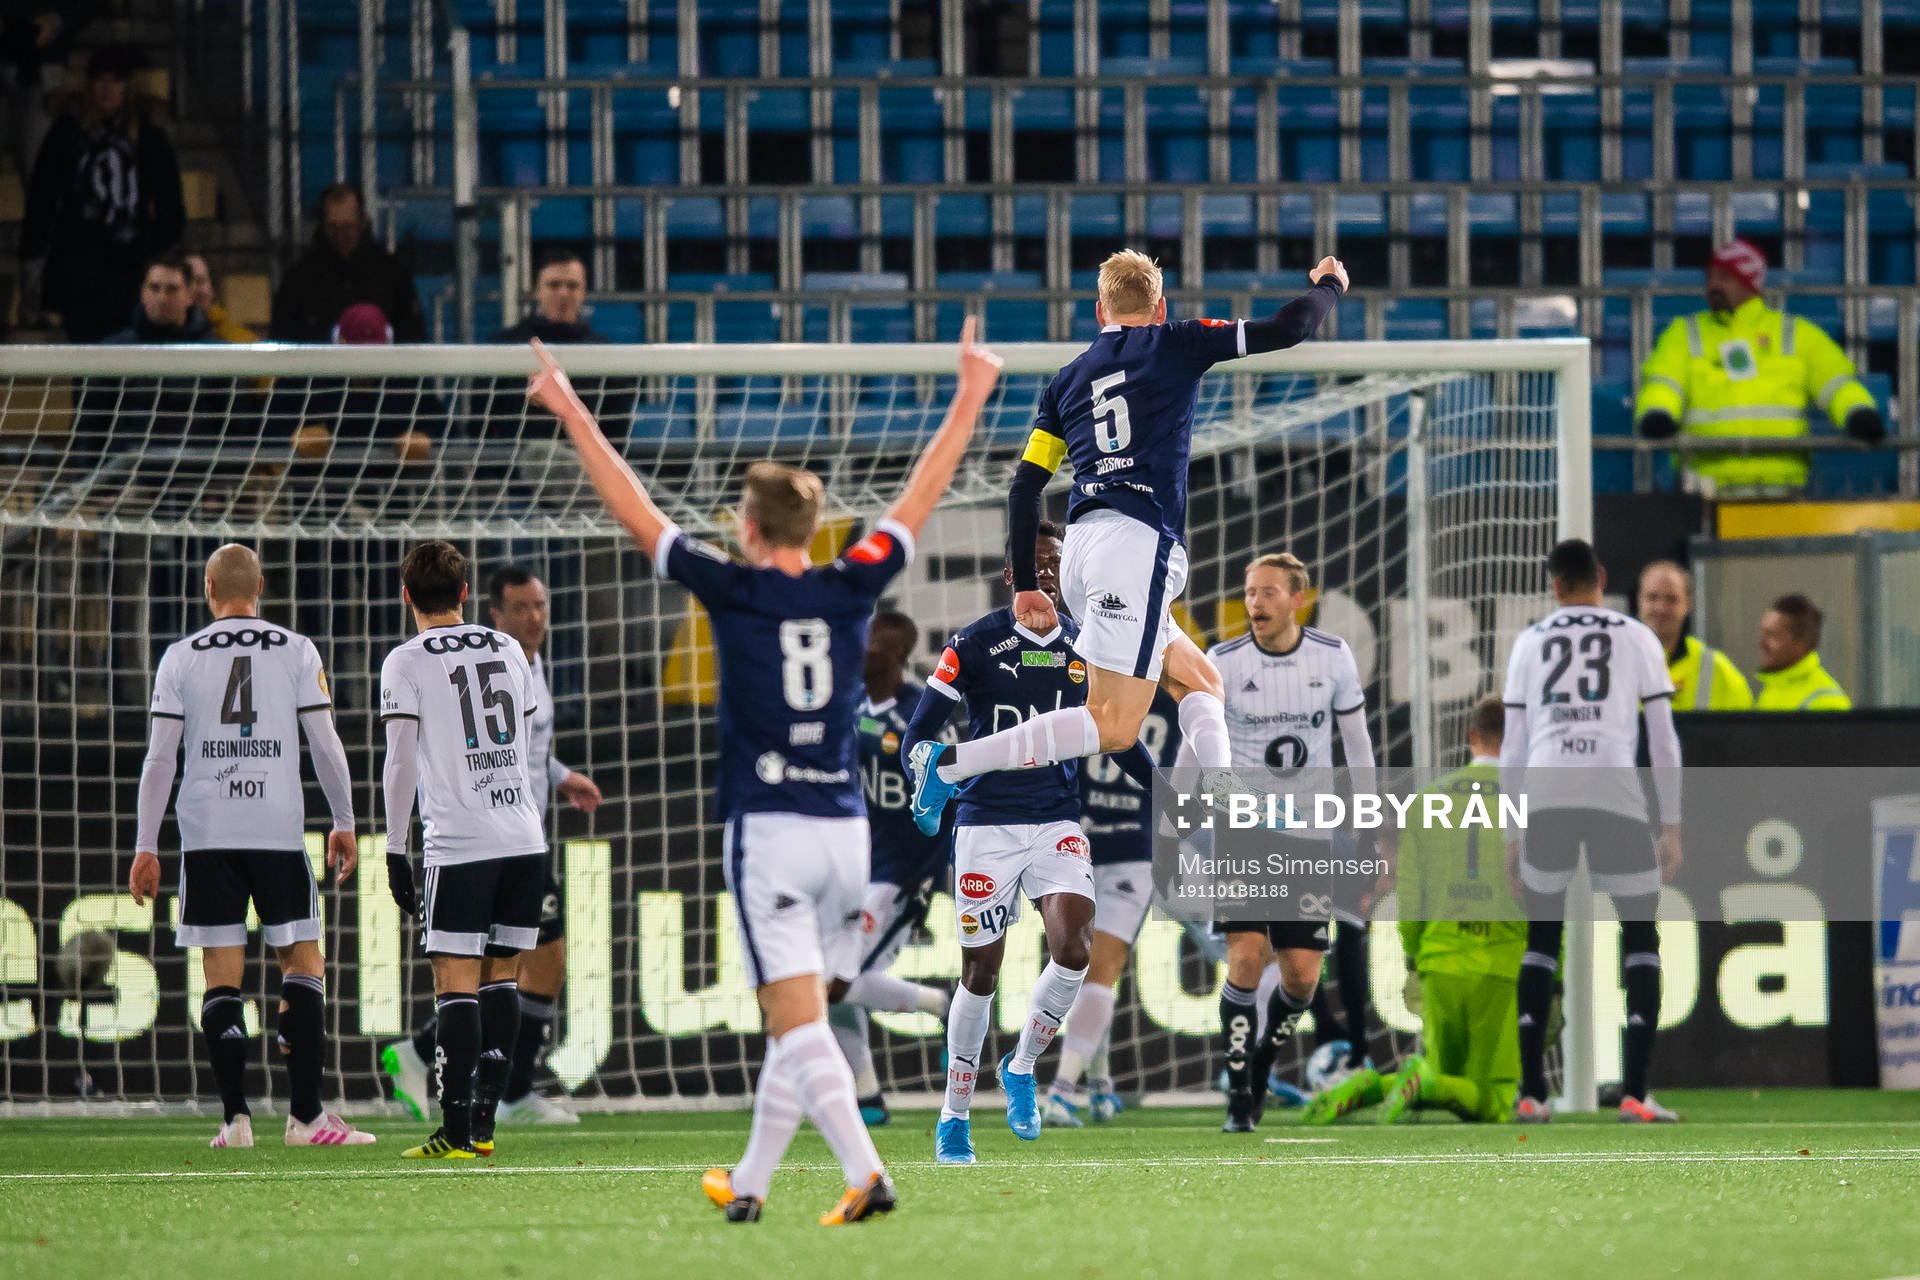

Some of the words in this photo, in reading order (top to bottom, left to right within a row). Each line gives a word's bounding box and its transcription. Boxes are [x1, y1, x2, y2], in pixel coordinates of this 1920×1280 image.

[1090, 369, 1131, 454] 5
[191, 629, 288, 651] coop
[423, 631, 509, 655] coop
[779, 617, 834, 712] 8
[1022, 651, 1053, 666] KIWI
[1541, 632, 1612, 706] 23
[221, 655, 258, 738] 4
[449, 660, 517, 750] 15
[202, 739, 282, 758] REGINIUSSEN
[1561, 738, 1598, 754] MOT
[229, 780, 265, 799] MOT
[491, 788, 522, 807] MOT
[960, 878, 996, 892] ARBO
[980, 904, 1008, 935] 42
